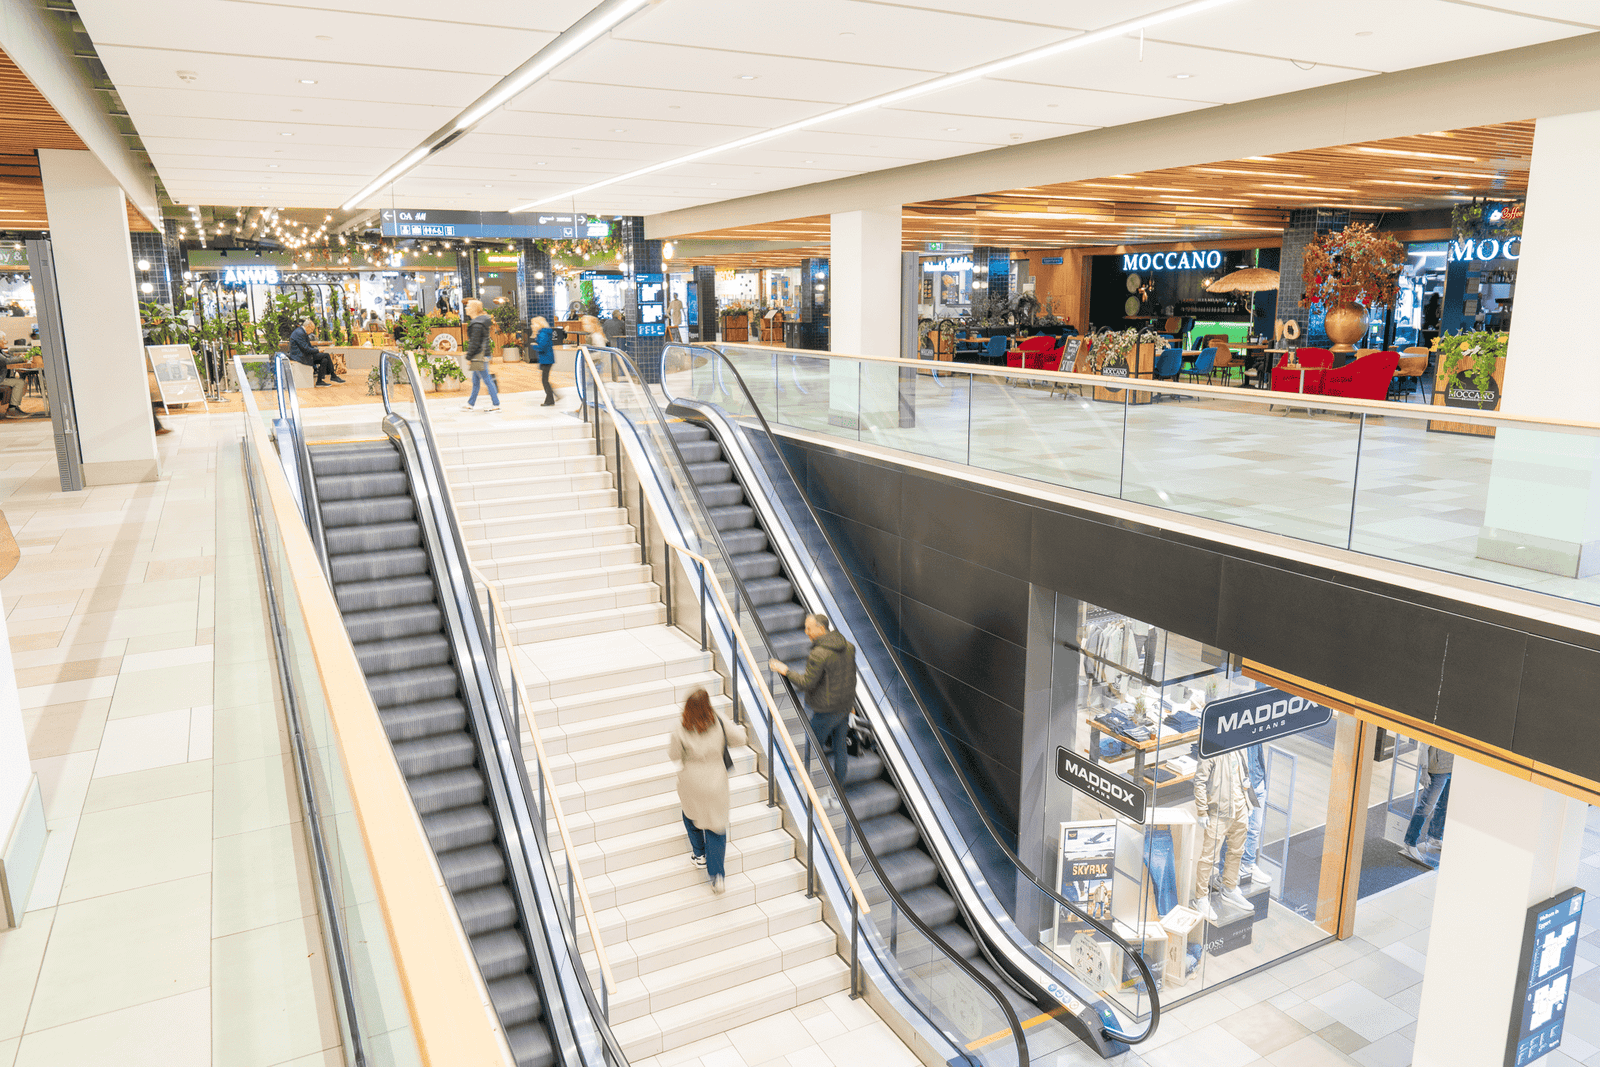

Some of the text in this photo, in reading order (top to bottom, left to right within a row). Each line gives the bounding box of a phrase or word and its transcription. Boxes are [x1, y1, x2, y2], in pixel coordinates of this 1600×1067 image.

[1123, 250, 1221, 271] MOCCANO
[224, 266, 279, 285] ANWB
[1252, 719, 1287, 734] JEANS
[1065, 759, 1135, 807] MADDOX
[1087, 784, 1111, 800] JEANS
[1072, 863, 1109, 876] SKYRAK
[1203, 937, 1224, 951] BOSS
